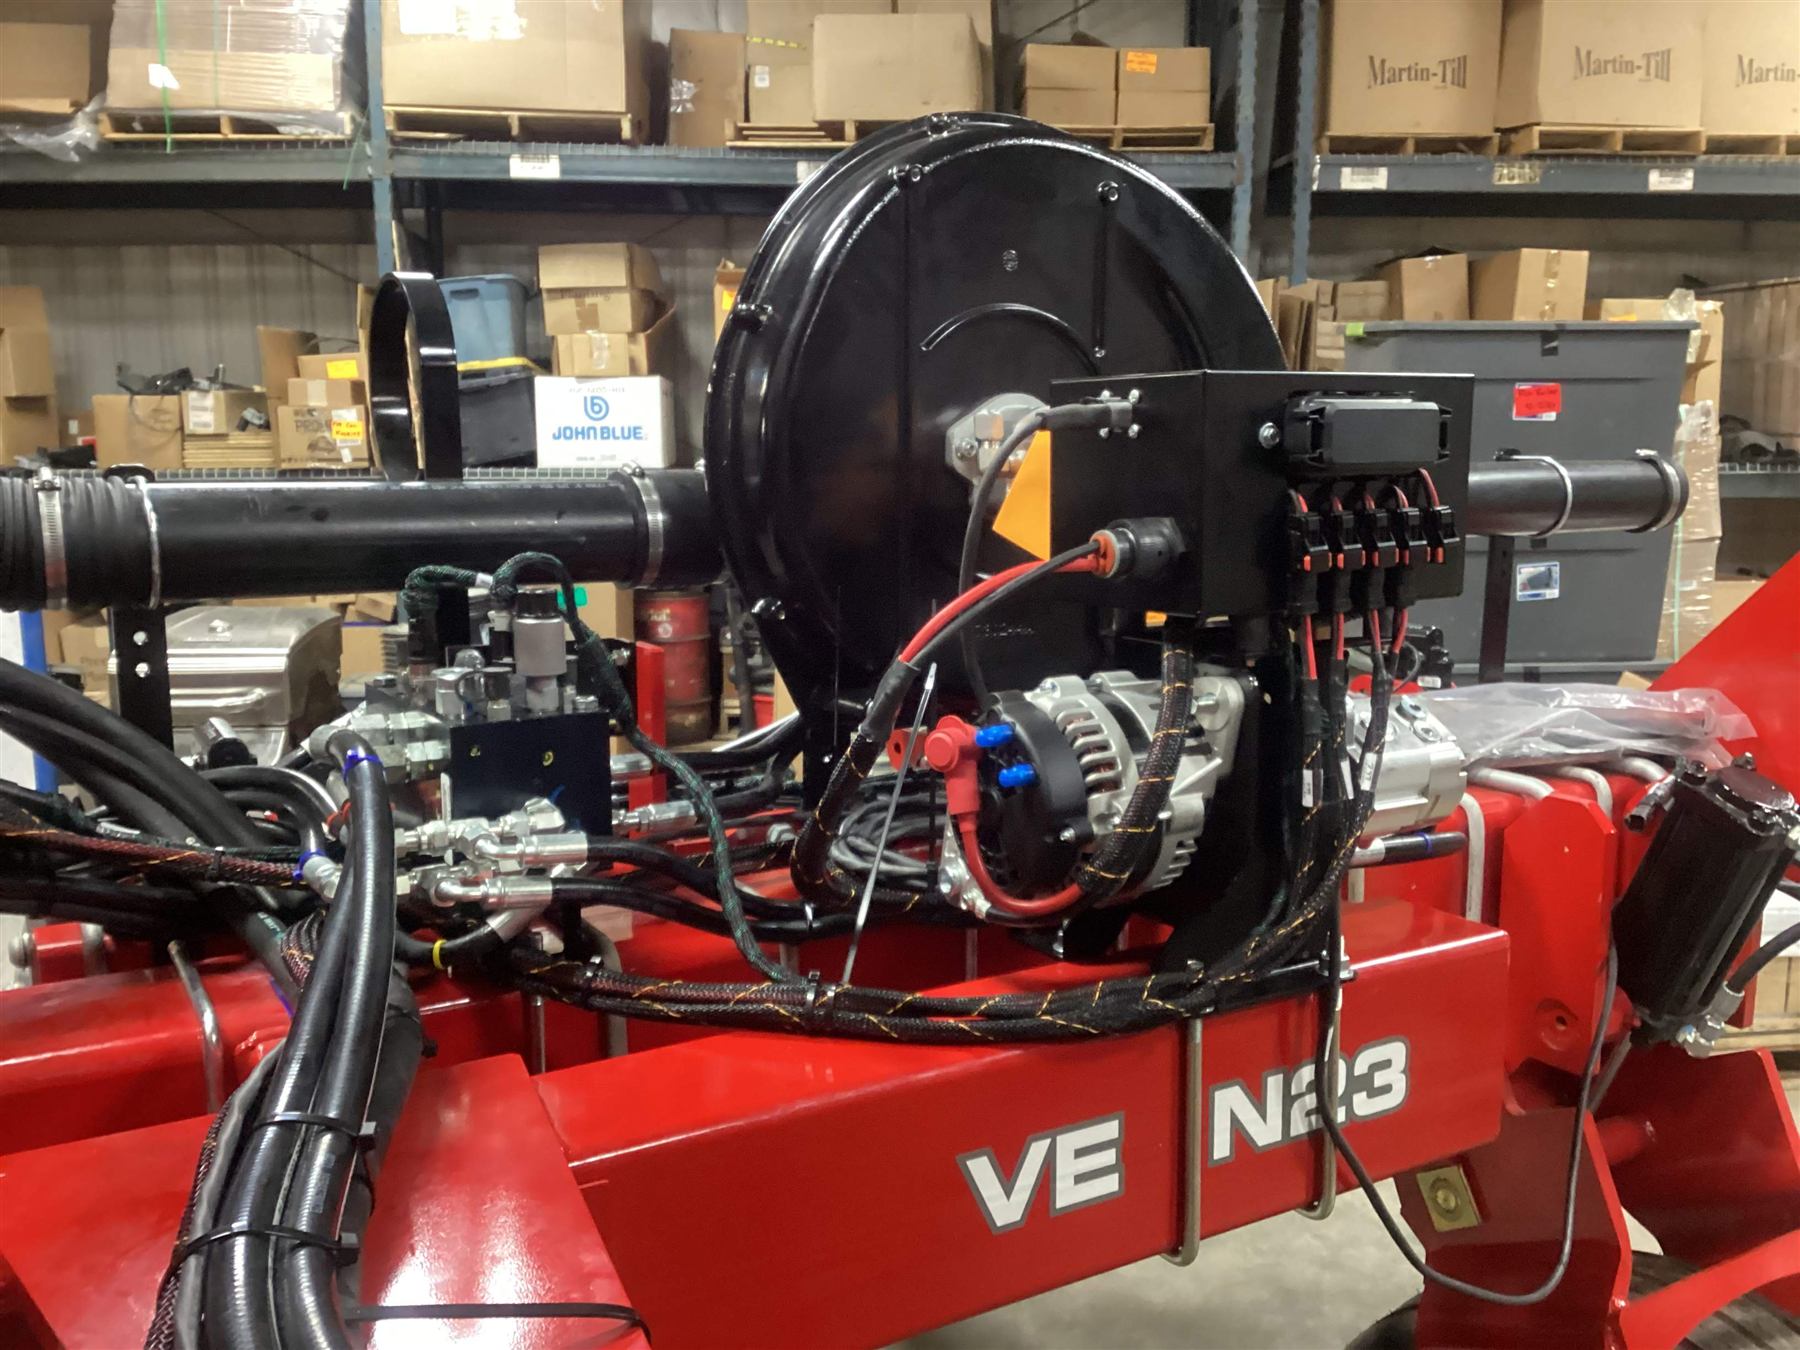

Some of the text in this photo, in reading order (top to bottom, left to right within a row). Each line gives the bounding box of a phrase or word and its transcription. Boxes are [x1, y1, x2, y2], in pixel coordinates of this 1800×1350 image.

[1367, 54, 1468, 89] Martin-Till
[1573, 45, 1672, 82] Martin-Till
[552, 425, 644, 441] JOHN BLUE
[1209, 1037, 1409, 1167] N23
